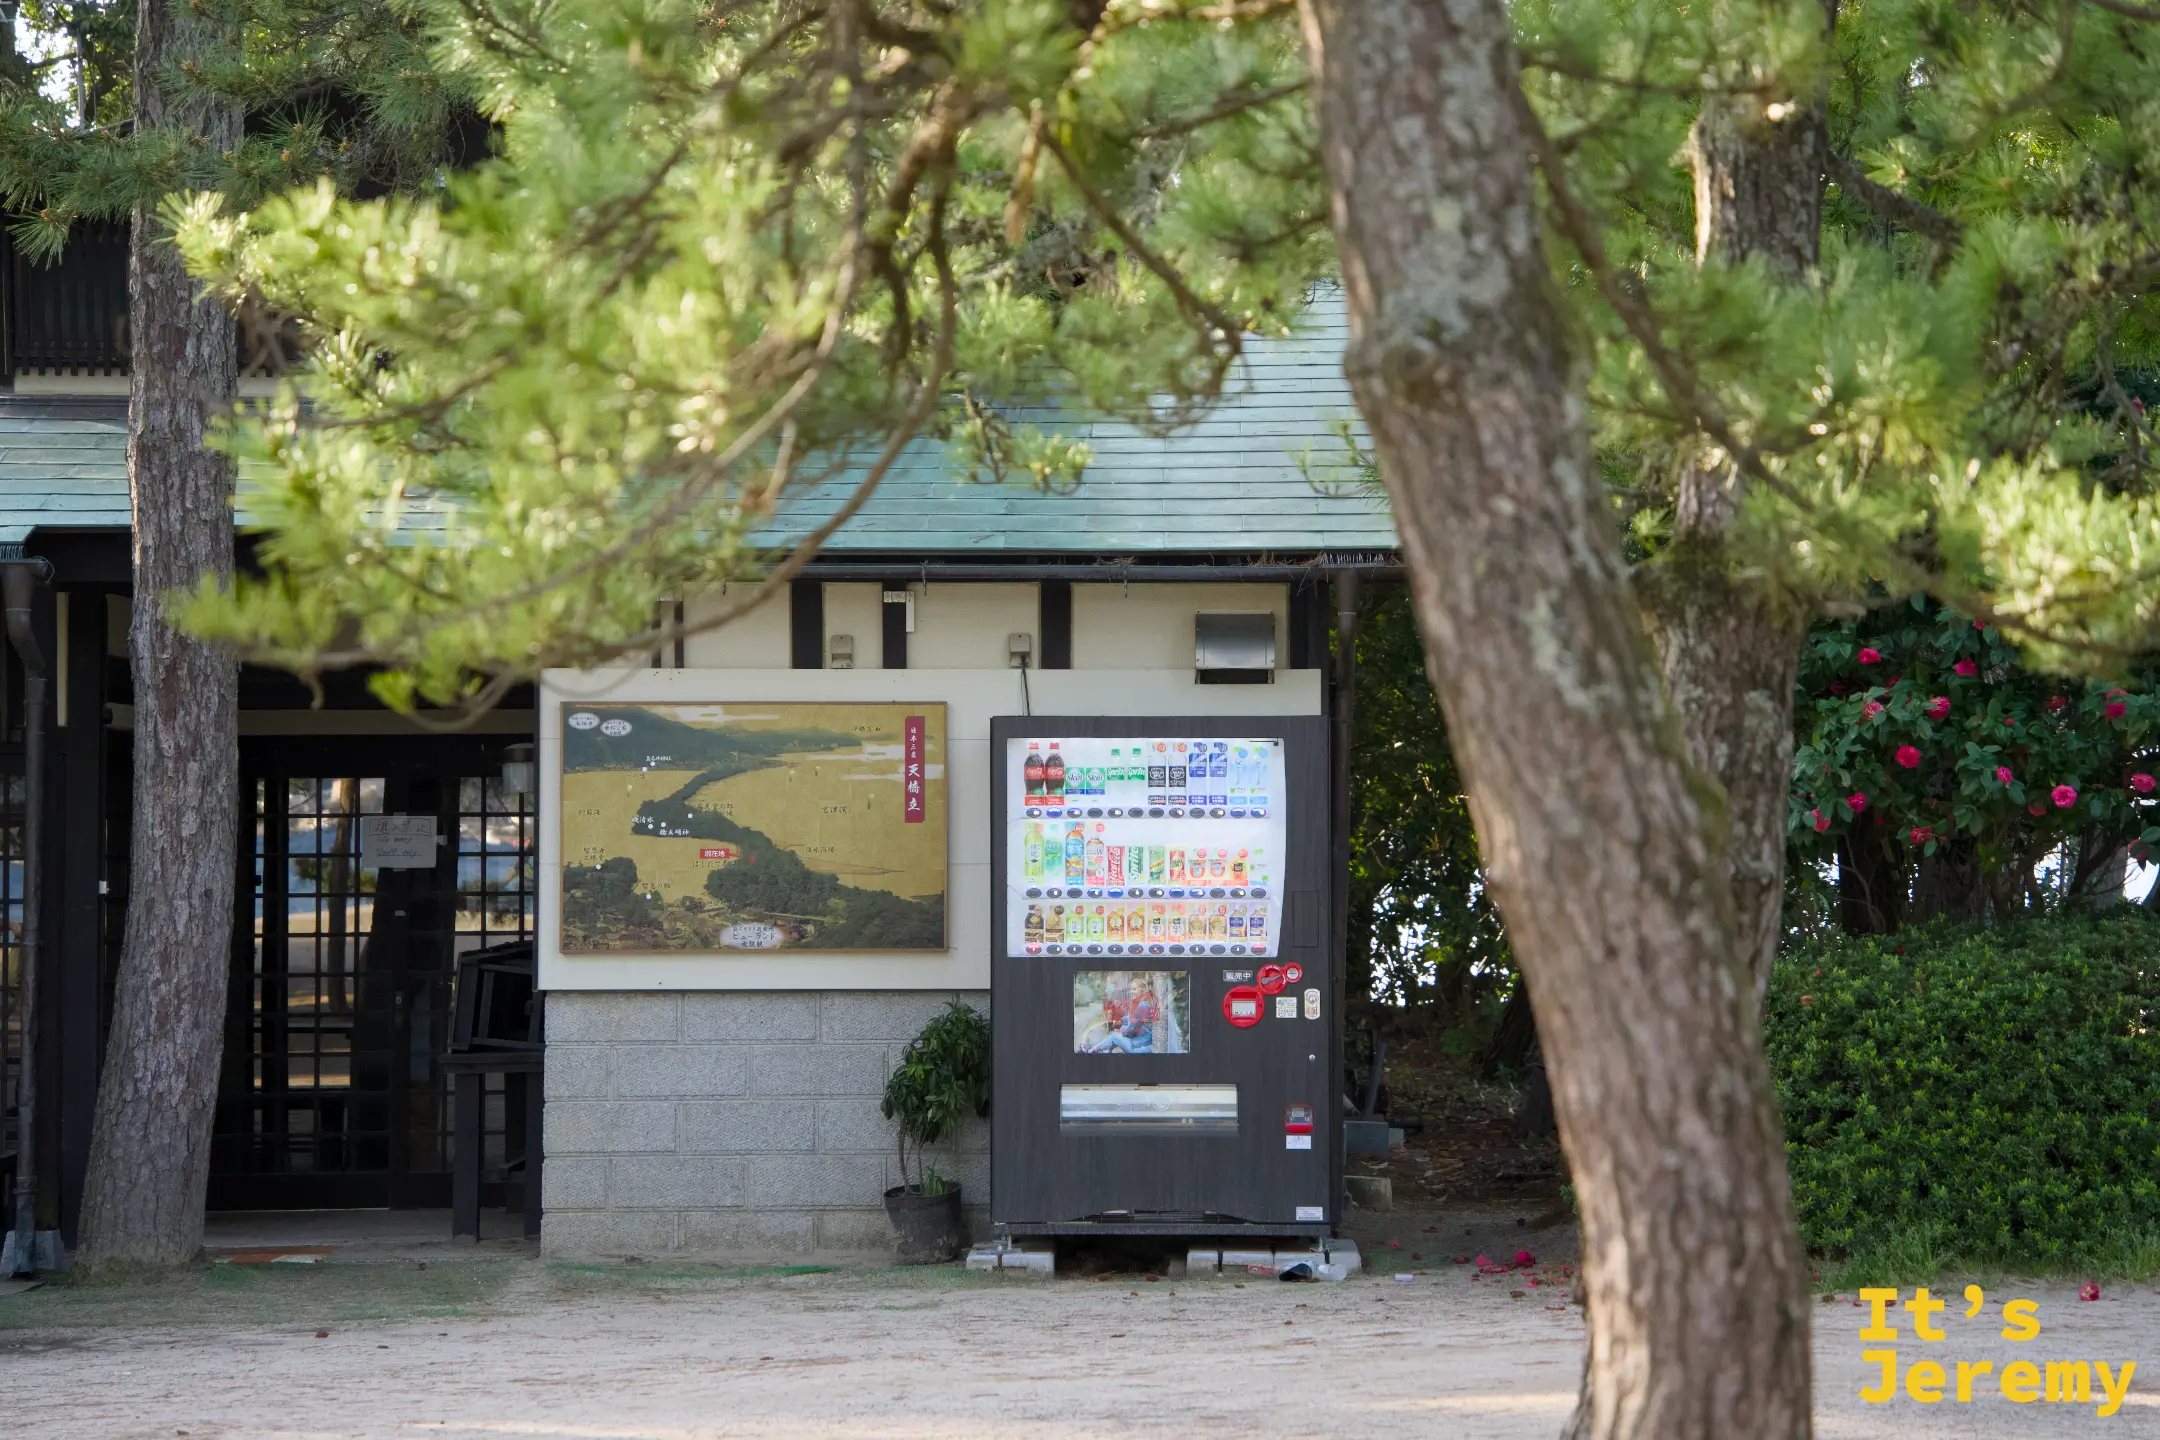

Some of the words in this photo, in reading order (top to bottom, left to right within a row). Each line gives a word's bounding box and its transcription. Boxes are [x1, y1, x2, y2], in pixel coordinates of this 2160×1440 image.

[910, 726, 918, 759] 日本三景
[907, 763, 921, 812] 天橋立
[704, 849, 726, 858] 現在地
[1225, 971, 1251, 980] 販売中
